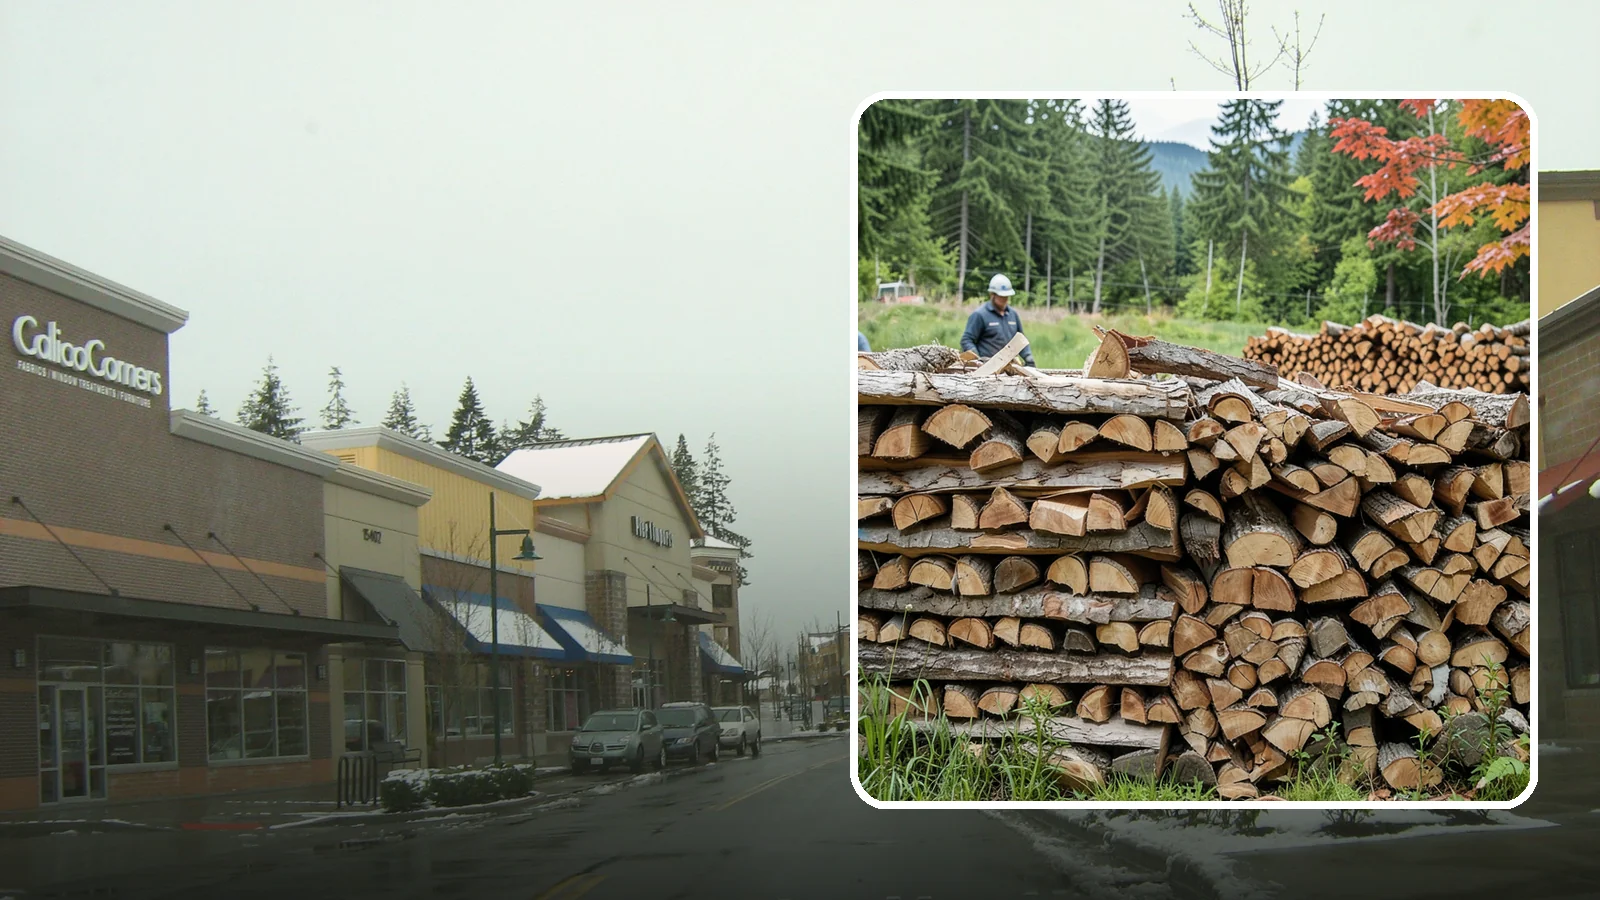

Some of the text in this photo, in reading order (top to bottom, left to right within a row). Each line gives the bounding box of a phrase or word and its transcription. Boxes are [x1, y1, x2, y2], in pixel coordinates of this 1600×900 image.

[17, 360, 47, 378] FABRICS
[51, 370, 78, 387] WINDOW
[78, 378, 116, 398] TREATMENTS
[120, 390, 152, 409] FURNITURE
